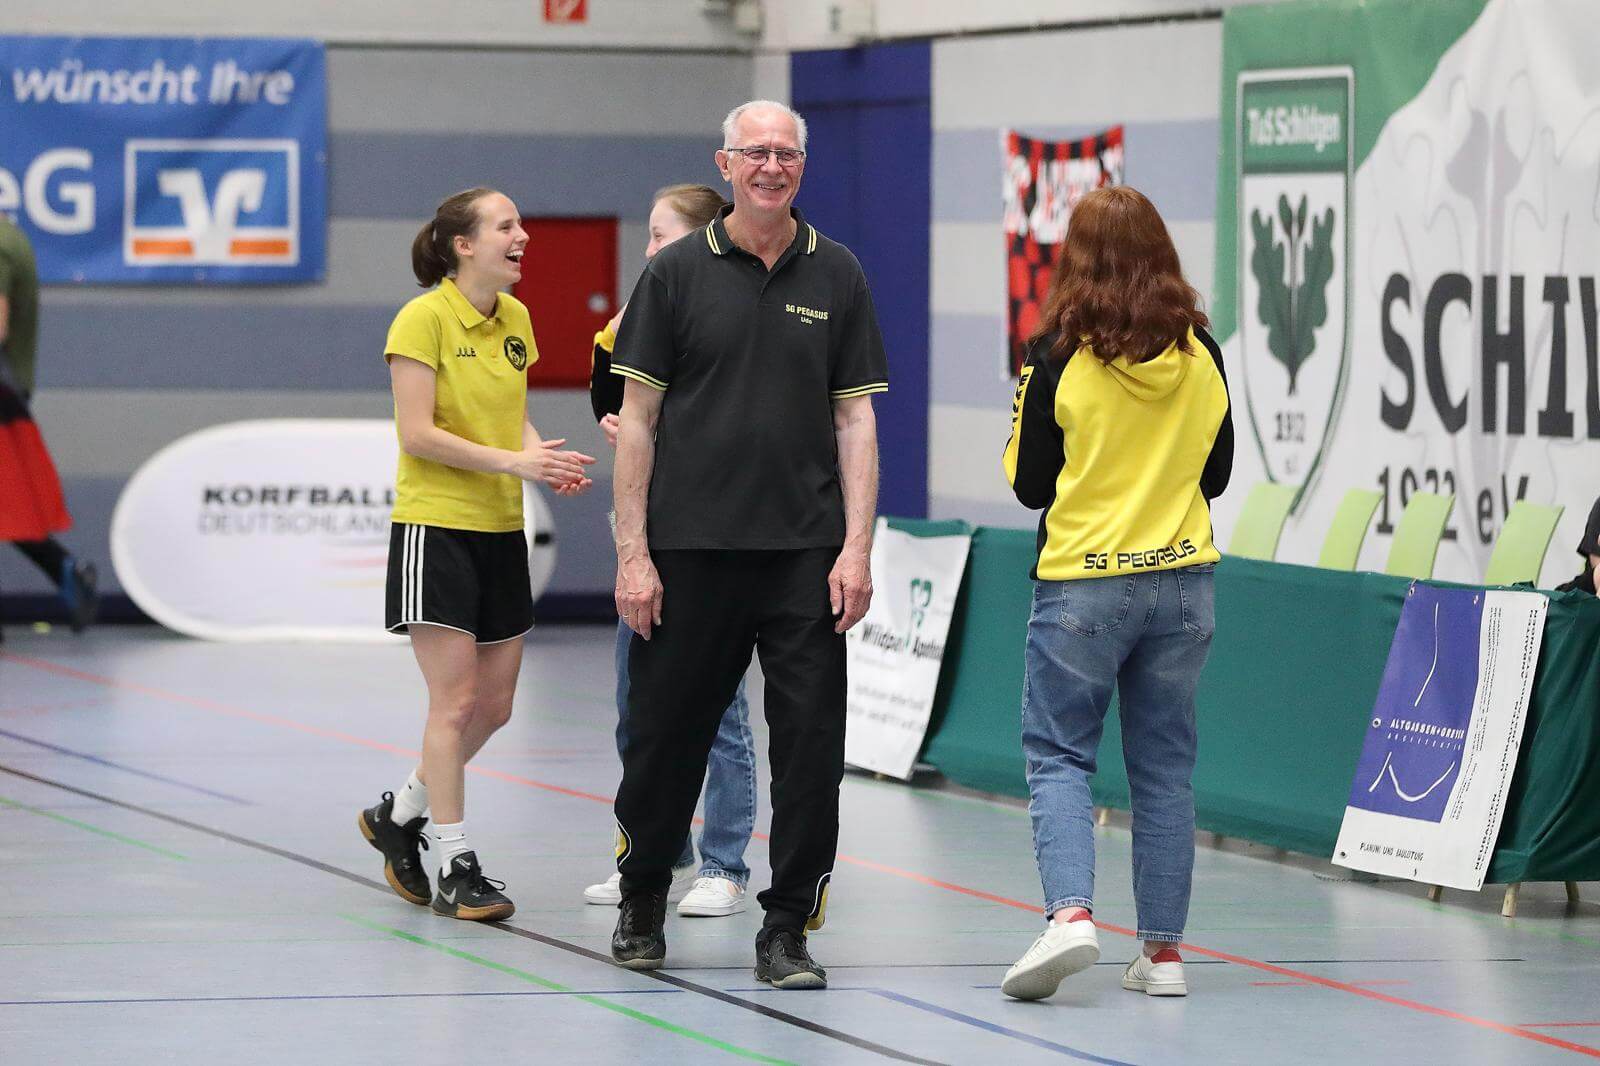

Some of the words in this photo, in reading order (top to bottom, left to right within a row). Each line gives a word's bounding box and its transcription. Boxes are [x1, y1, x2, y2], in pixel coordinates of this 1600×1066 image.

[12, 58, 201, 105] wünscht
[208, 58, 295, 105] Ihre
[785, 303, 796, 313] SG
[796, 306, 829, 320] PEGASUS
[199, 511, 388, 535] DEUTSCHLAN
[1084, 552, 1108, 570] SG
[1116, 538, 1197, 570] PEGASUS
